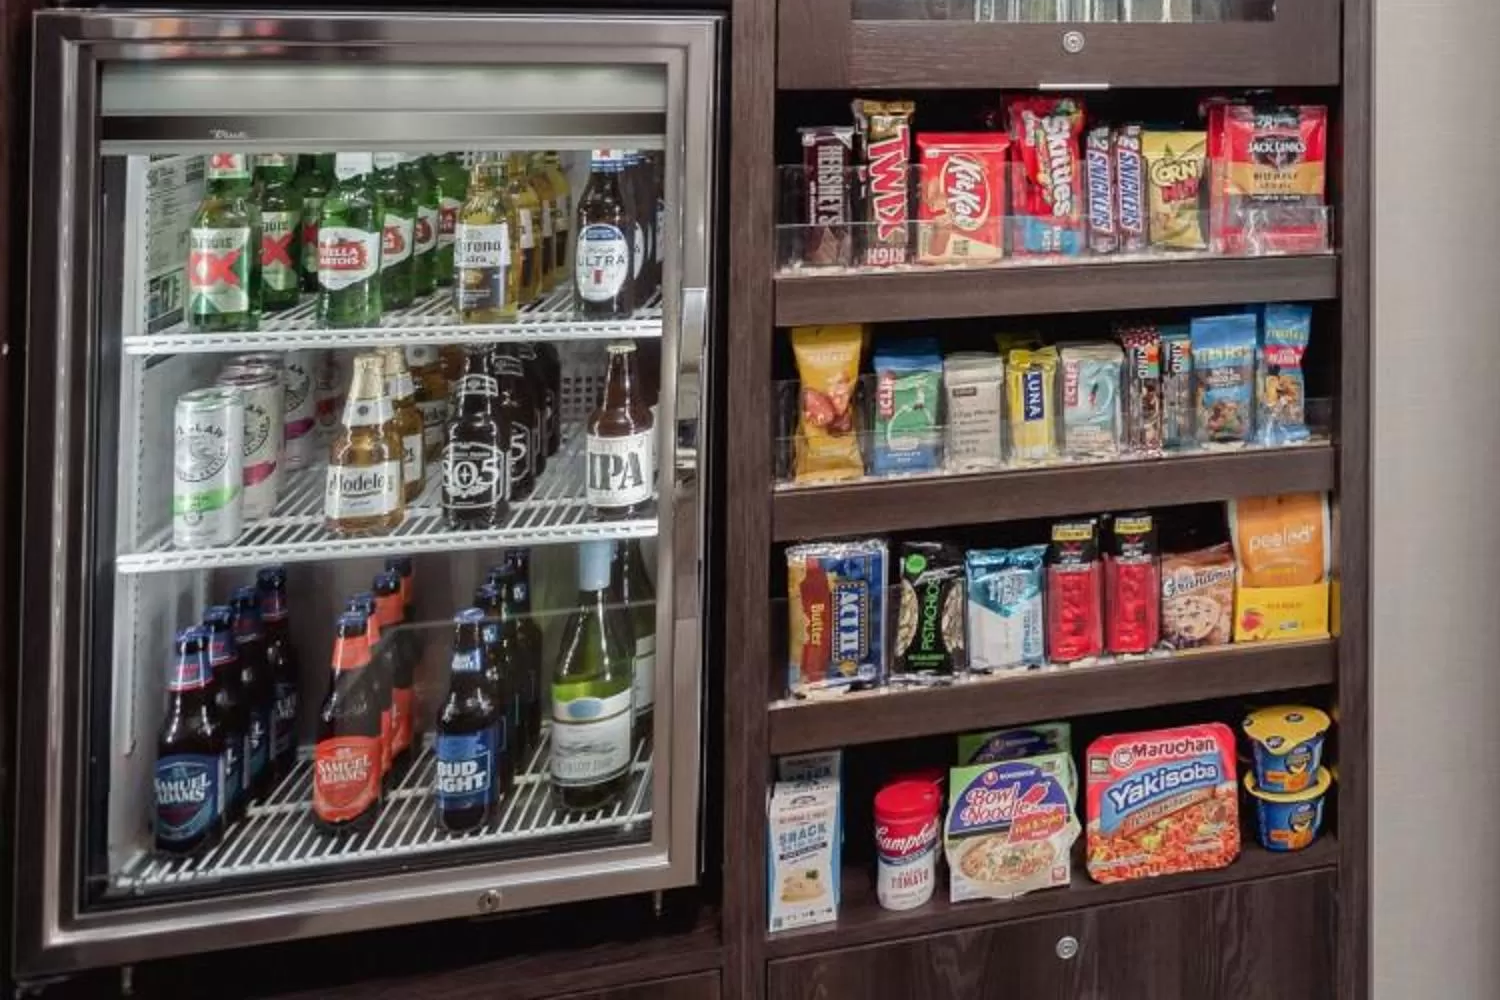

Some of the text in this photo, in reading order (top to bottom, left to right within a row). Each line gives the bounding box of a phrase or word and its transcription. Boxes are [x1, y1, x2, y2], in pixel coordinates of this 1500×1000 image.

[868, 125, 910, 242] TWIX
[1089, 152, 1113, 231] SNICKERS
[1119, 152, 1142, 231] SNICKERS
[1152, 161, 1198, 185] CORN
[1025, 371, 1042, 418] LUNA
[589, 452, 643, 491] IPA
[1248, 526, 1314, 553] peeled
[811, 602, 825, 646] Butter
[921, 577, 941, 651] PISTACHIOS
[318, 756, 371, 774] SAMUEL
[1132, 735, 1216, 760] Maruchan
[155, 773, 212, 795] SAMUEL
[1108, 762, 1217, 814] Yakisoba
